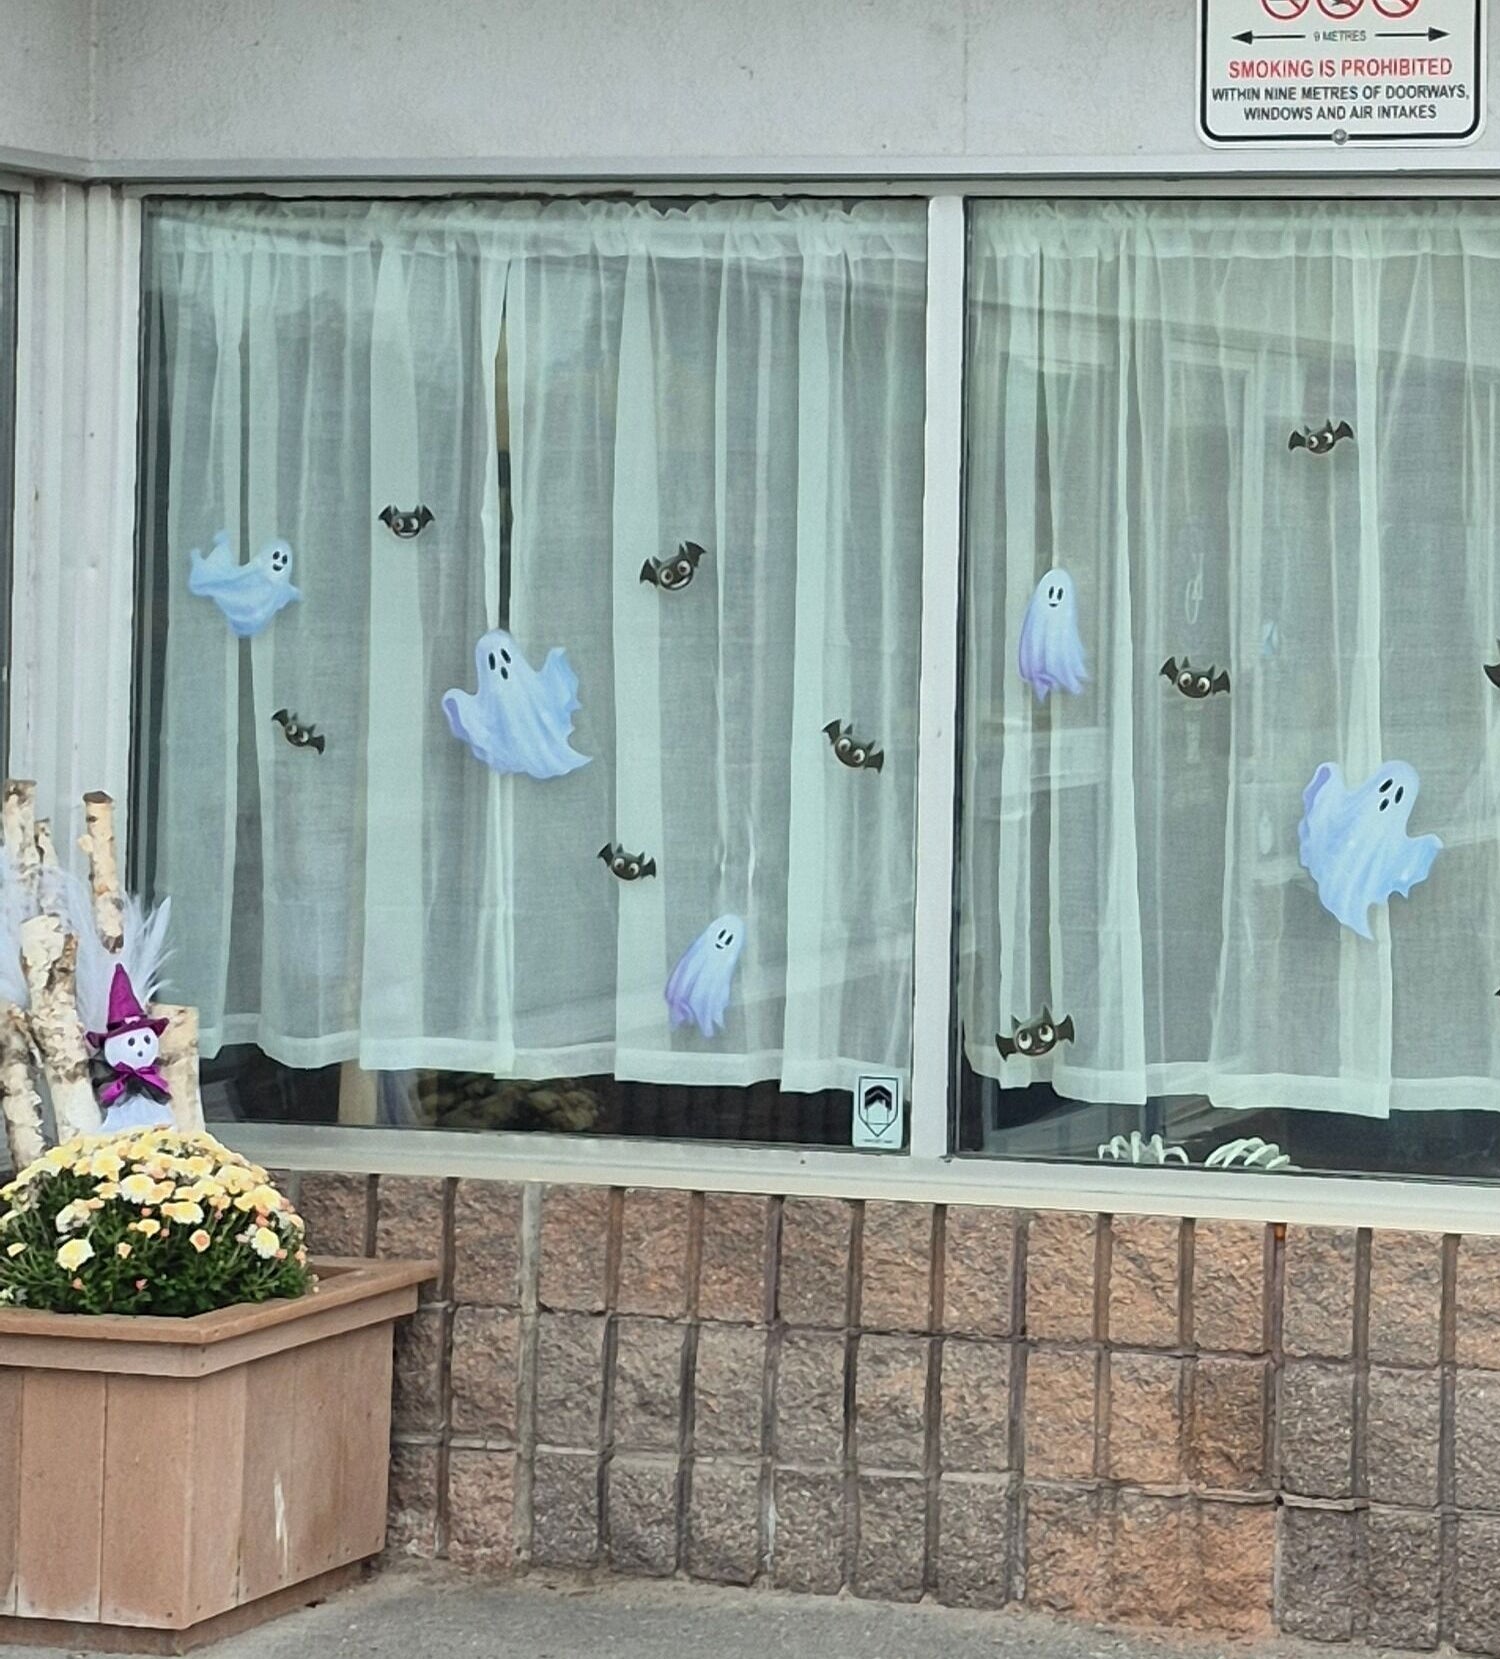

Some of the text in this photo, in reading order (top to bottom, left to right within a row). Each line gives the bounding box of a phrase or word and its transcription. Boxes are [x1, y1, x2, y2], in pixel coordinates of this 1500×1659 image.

[1313, 30, 1366, 42] 9 METRES
[1229, 58, 1453, 78] SMOKING IS PROHIBITED
[1212, 84, 1470, 101] WITHIN NINE METRES OF DOORWAYS,
[1244, 104, 1437, 120] WINDOWS AND AIR INTAKES
